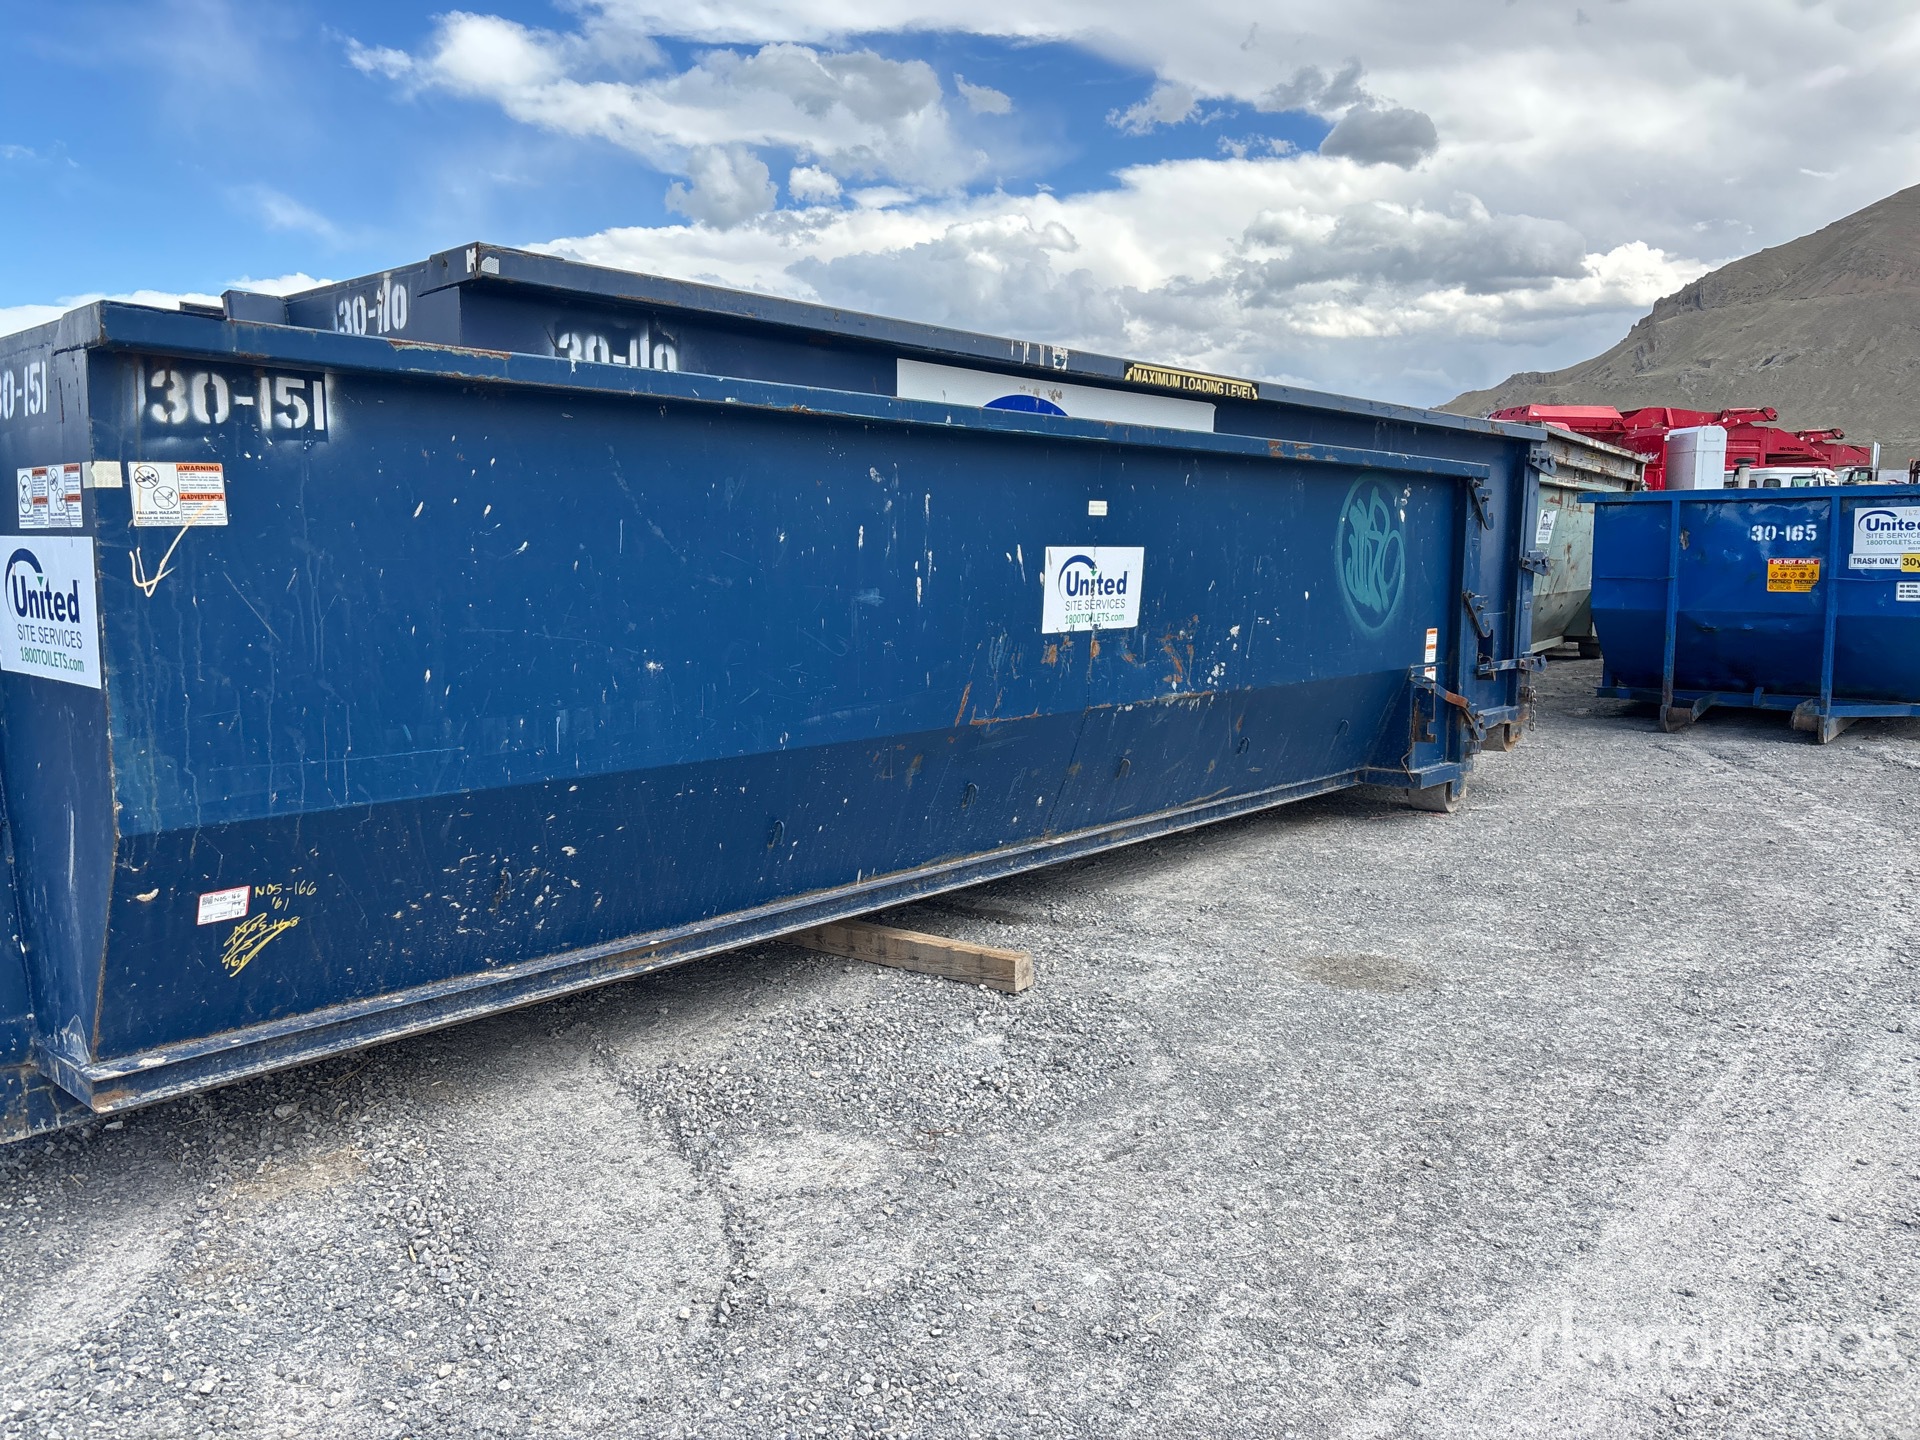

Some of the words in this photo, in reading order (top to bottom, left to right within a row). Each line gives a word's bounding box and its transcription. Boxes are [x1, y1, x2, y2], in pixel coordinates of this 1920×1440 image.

[0, 361, 47, 420] 0-151
[1132, 368, 1181, 388] MAXIMUM
[1183, 376, 1224, 394] LOADING
[1226, 384, 1253, 400] LEVEL
[151, 369, 325, 432] 30-151
[1751, 524, 1817, 542] 30-165
[1866, 517, 1920, 531] Unite
[1853, 557, 1877, 565] TRASH
[1879, 557, 1899, 565] ONLY
[1066, 571, 1128, 597] United
[12, 575, 80, 624] United
[1065, 600, 1083, 612] SITE
[1084, 598, 1126, 611] SERVICES
[17, 623, 37, 643] SITE
[37, 625, 83, 650] SERVICES
[20, 645, 85, 673] 1800TOILETS.com
